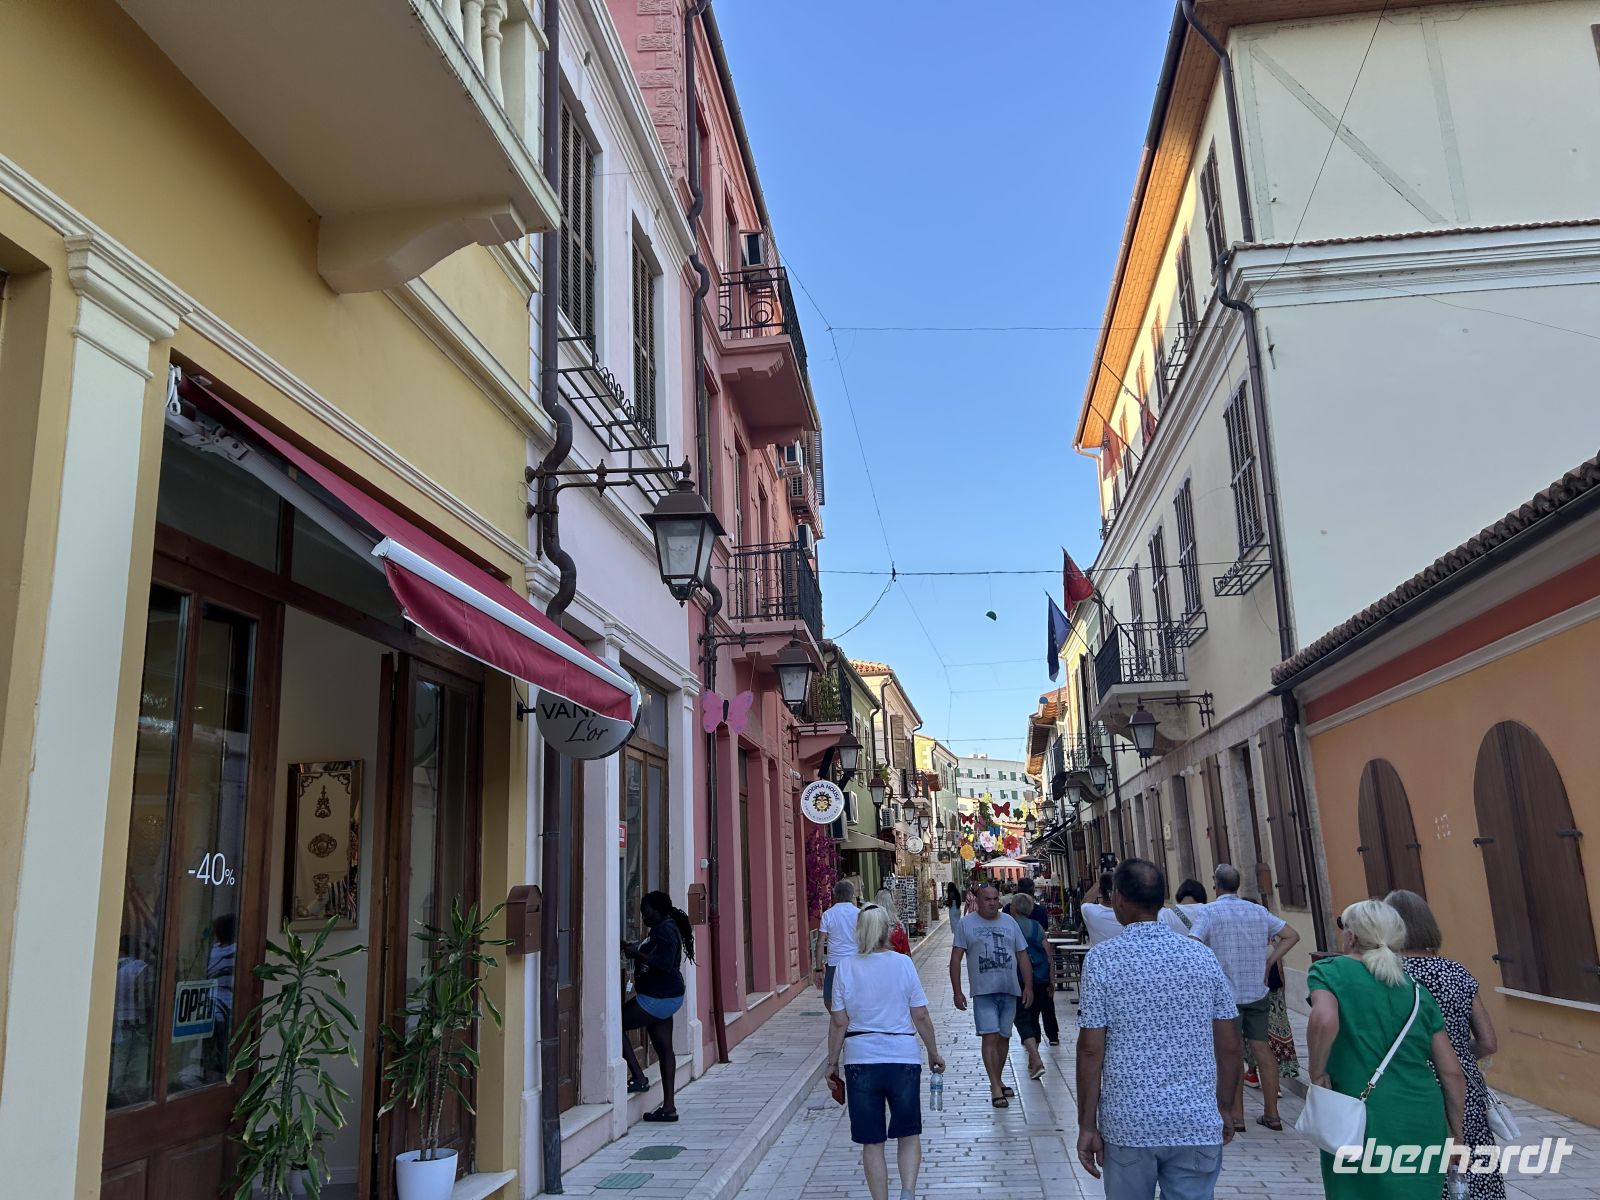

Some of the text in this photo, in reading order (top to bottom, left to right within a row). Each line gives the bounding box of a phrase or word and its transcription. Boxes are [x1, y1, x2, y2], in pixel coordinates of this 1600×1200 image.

[541, 702, 597, 720] VAN
[564, 718, 609, 743] L'or
[804, 783, 840, 801] BUDDHA HOUSE
[187, 852, 236, 886] -40%
[178, 987, 214, 1023] OPEN
